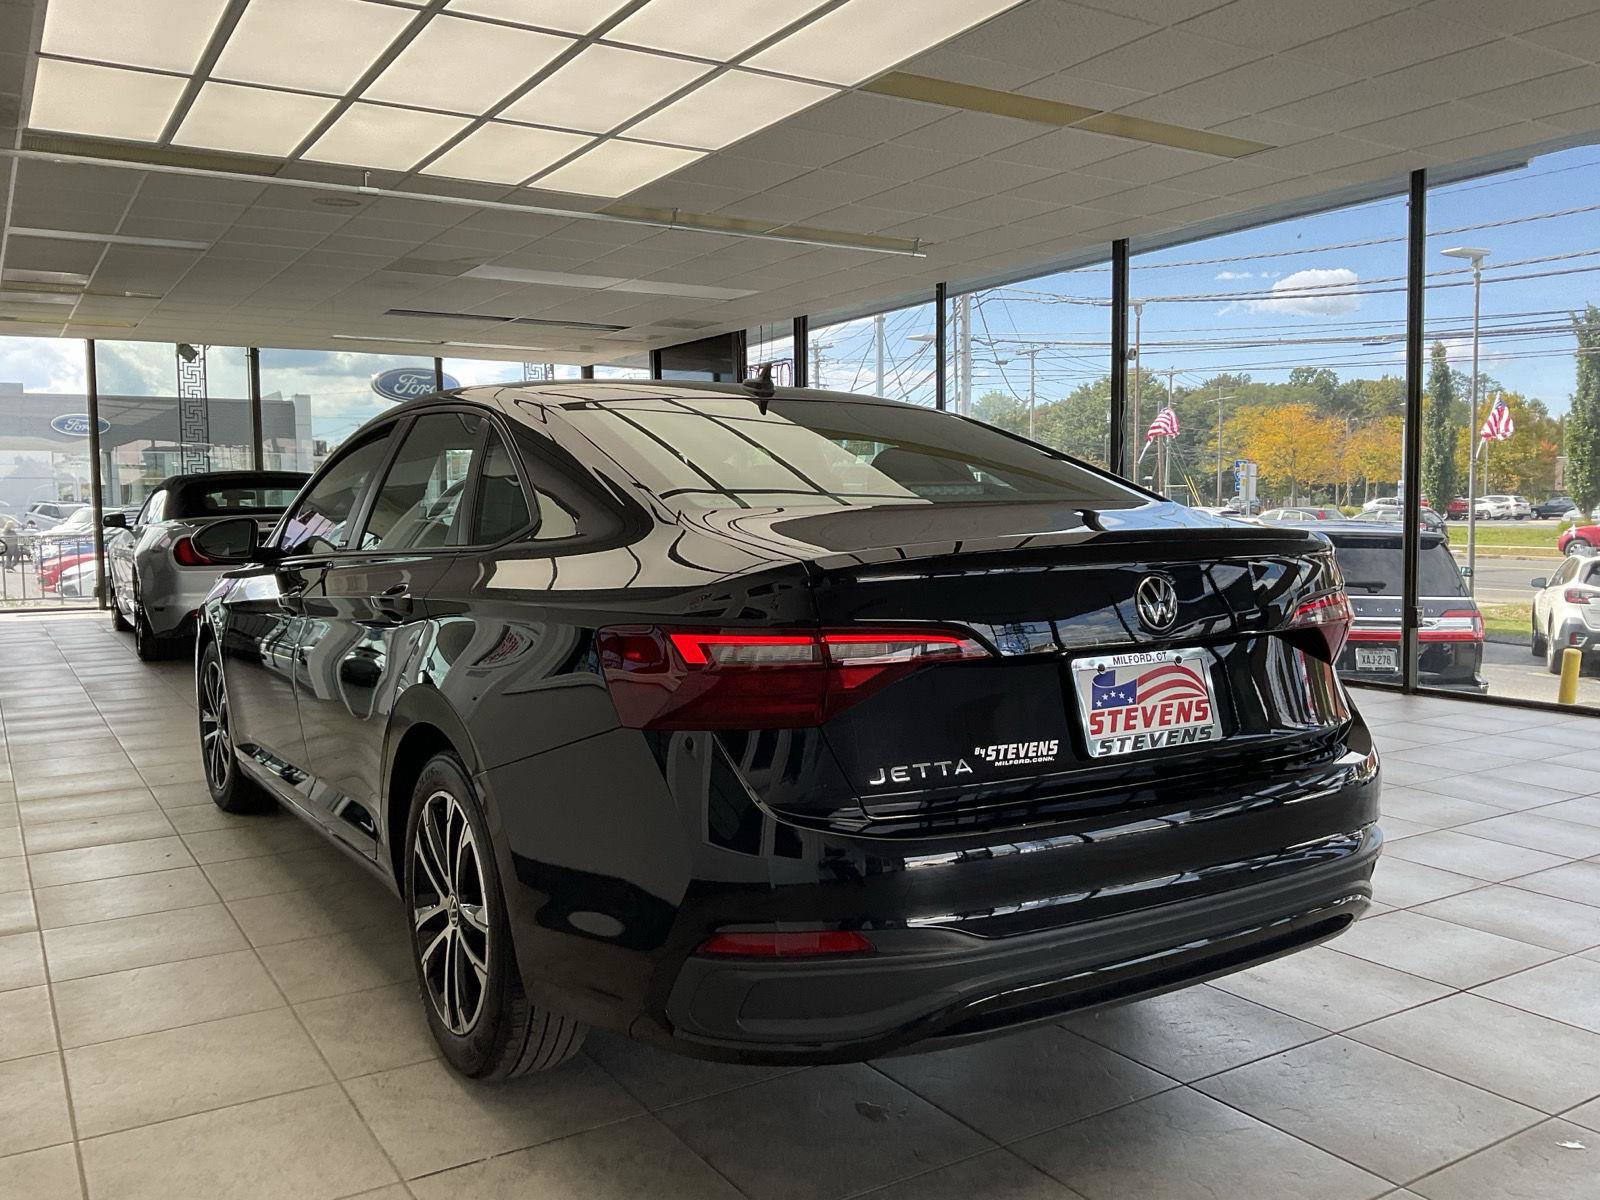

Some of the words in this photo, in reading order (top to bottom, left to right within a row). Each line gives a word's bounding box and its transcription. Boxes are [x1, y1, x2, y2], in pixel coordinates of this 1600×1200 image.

[64, 418, 90, 431] For
[1089, 699, 1209, 736] STEVENS
[986, 740, 1059, 761] STEVENS
[1098, 726, 1213, 755] STEVENS
[869, 758, 973, 785] JETTA
